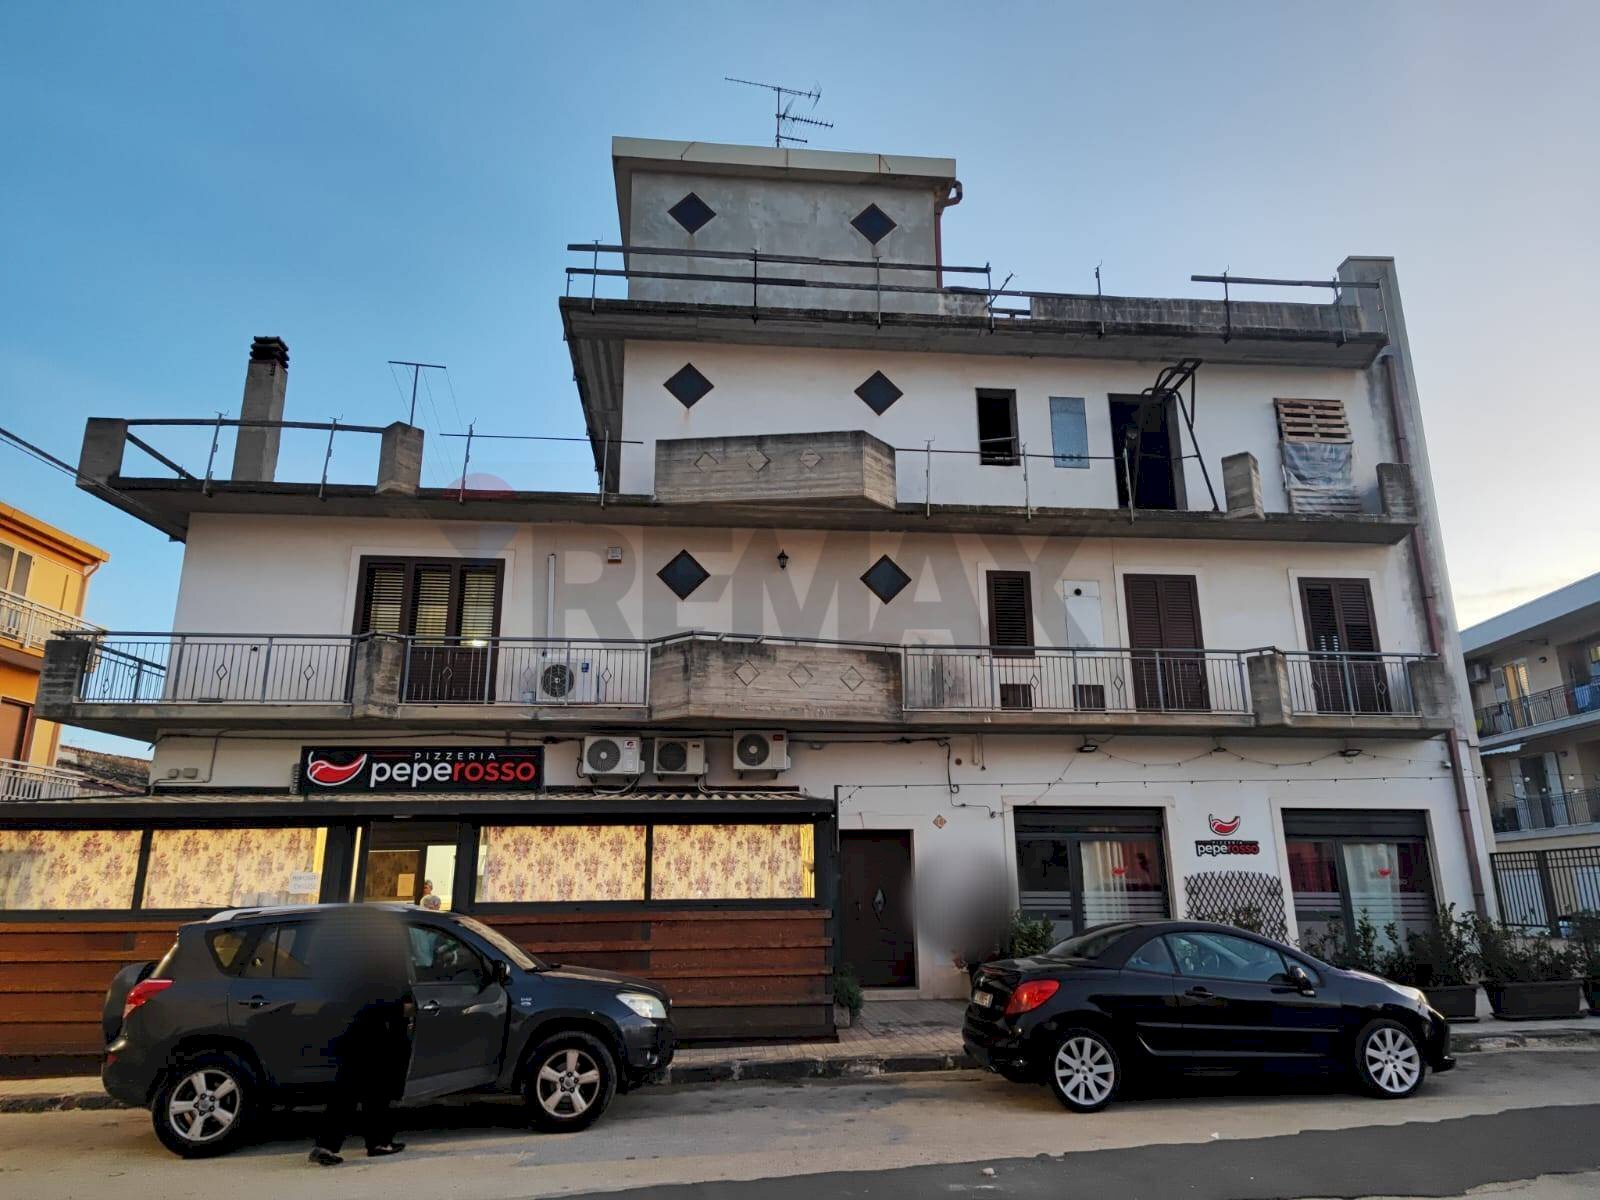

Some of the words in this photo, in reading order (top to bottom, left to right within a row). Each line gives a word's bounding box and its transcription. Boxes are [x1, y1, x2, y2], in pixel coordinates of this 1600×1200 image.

[414, 752, 496, 760] PIZZERIA
[370, 761, 536, 788] peperosso
[1197, 844, 1259, 856] peperosso
